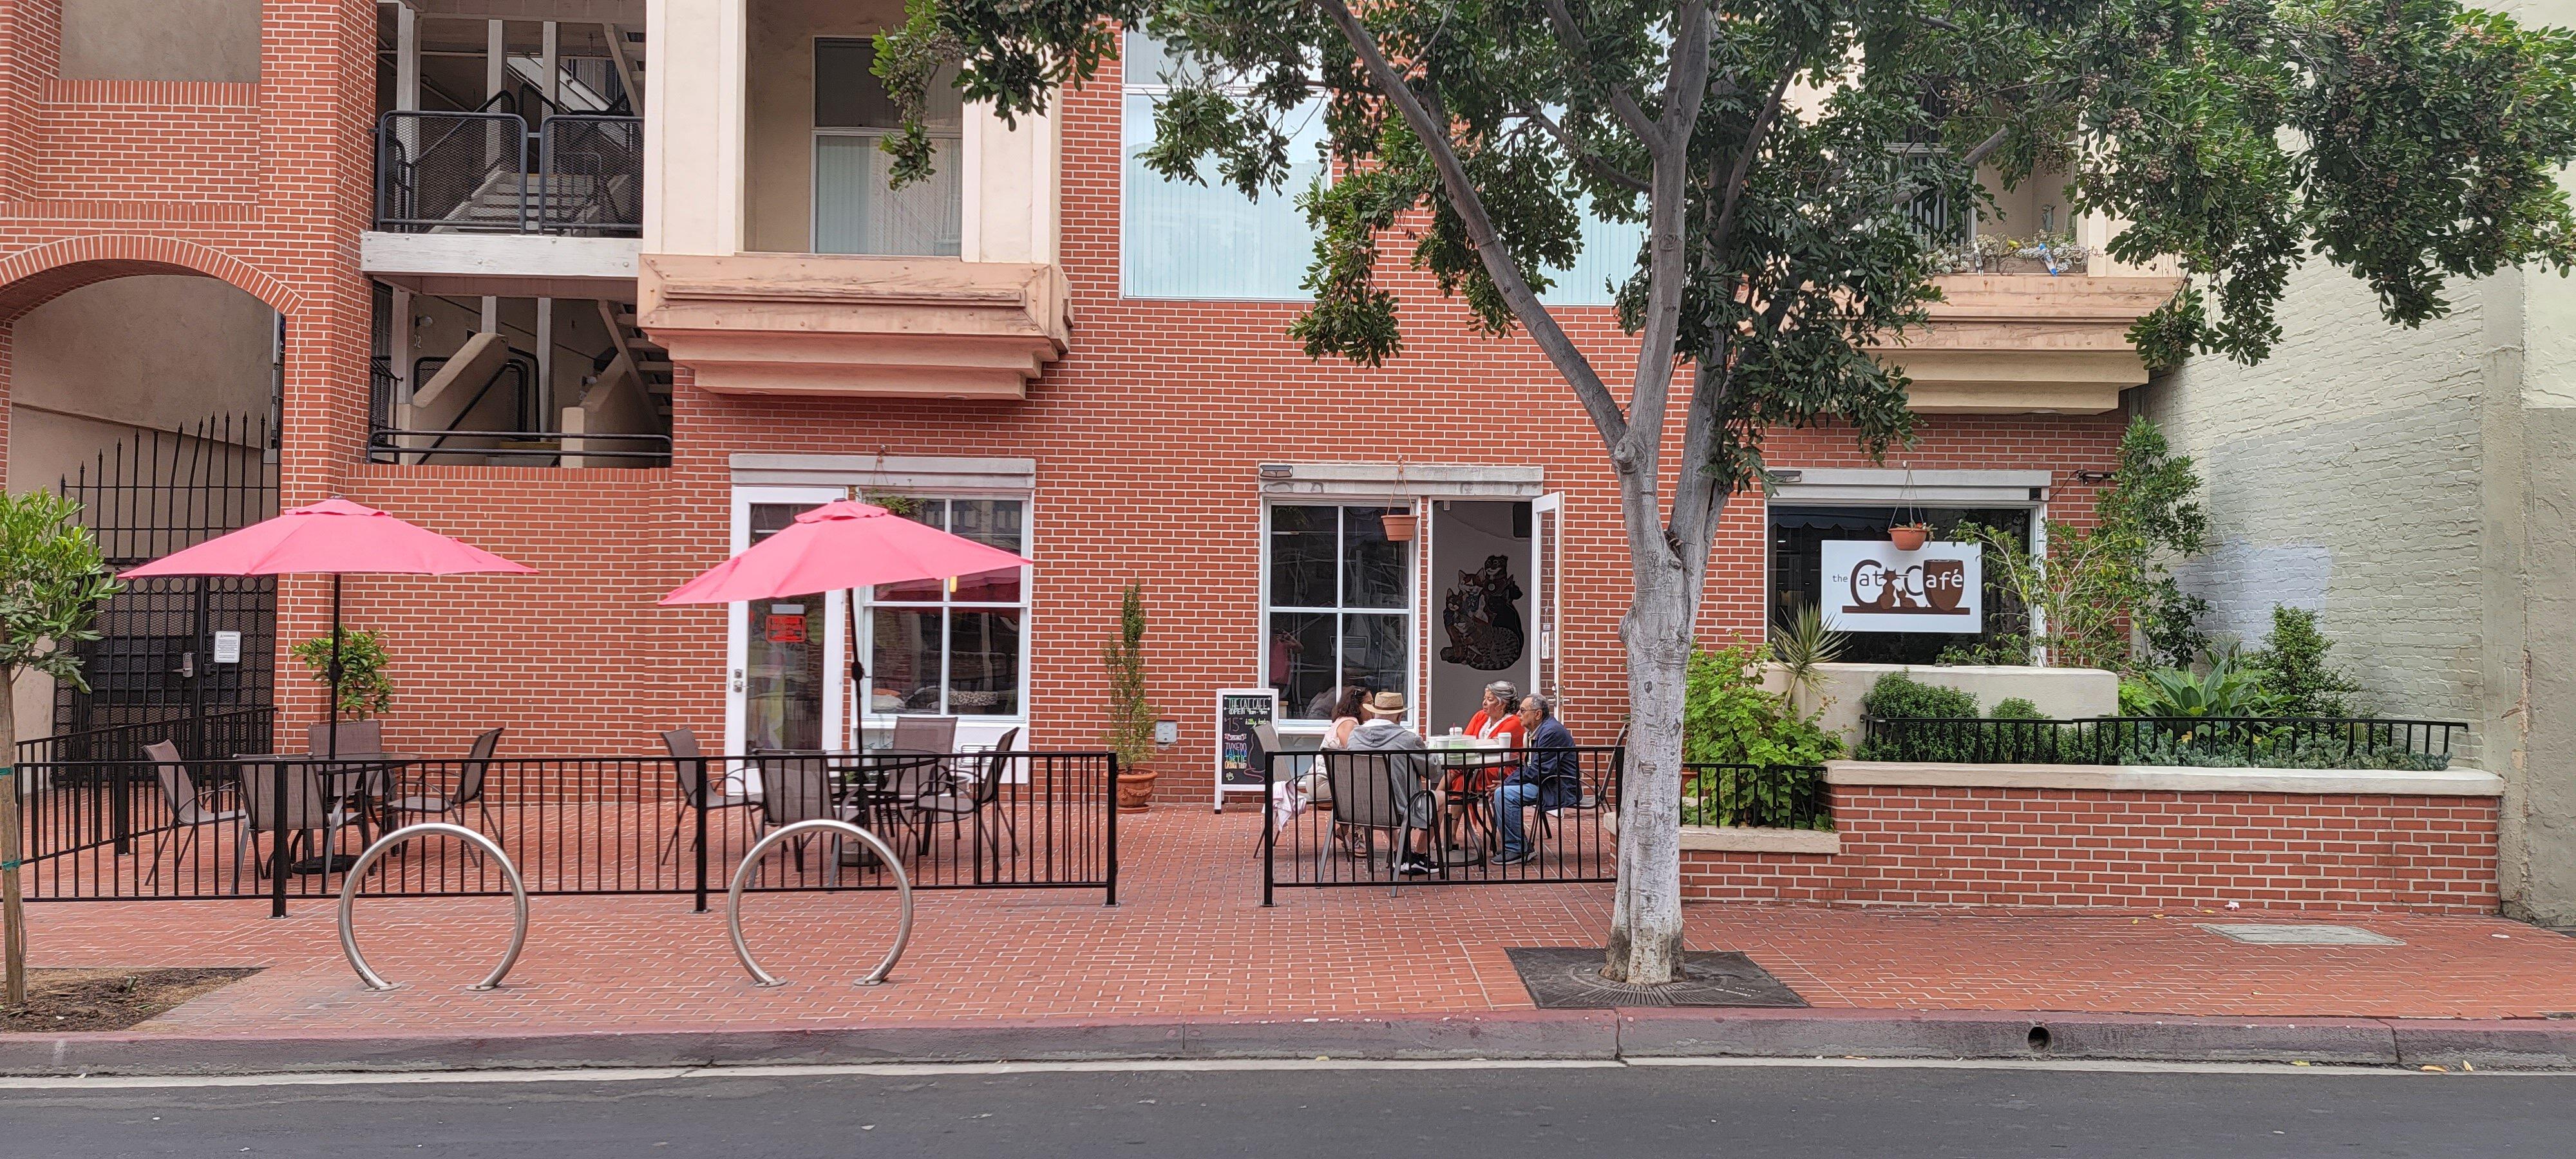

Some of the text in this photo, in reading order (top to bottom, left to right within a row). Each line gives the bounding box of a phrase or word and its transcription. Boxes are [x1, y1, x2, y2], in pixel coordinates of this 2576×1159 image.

[1832, 574, 1848, 583] the
[1904, 565, 1964, 596] Café
[1227, 697, 1267, 710] THE CAT CAFE
[1224, 742, 1247, 751] TUXEDO
[1224, 755, 1247, 764] TORTIE
